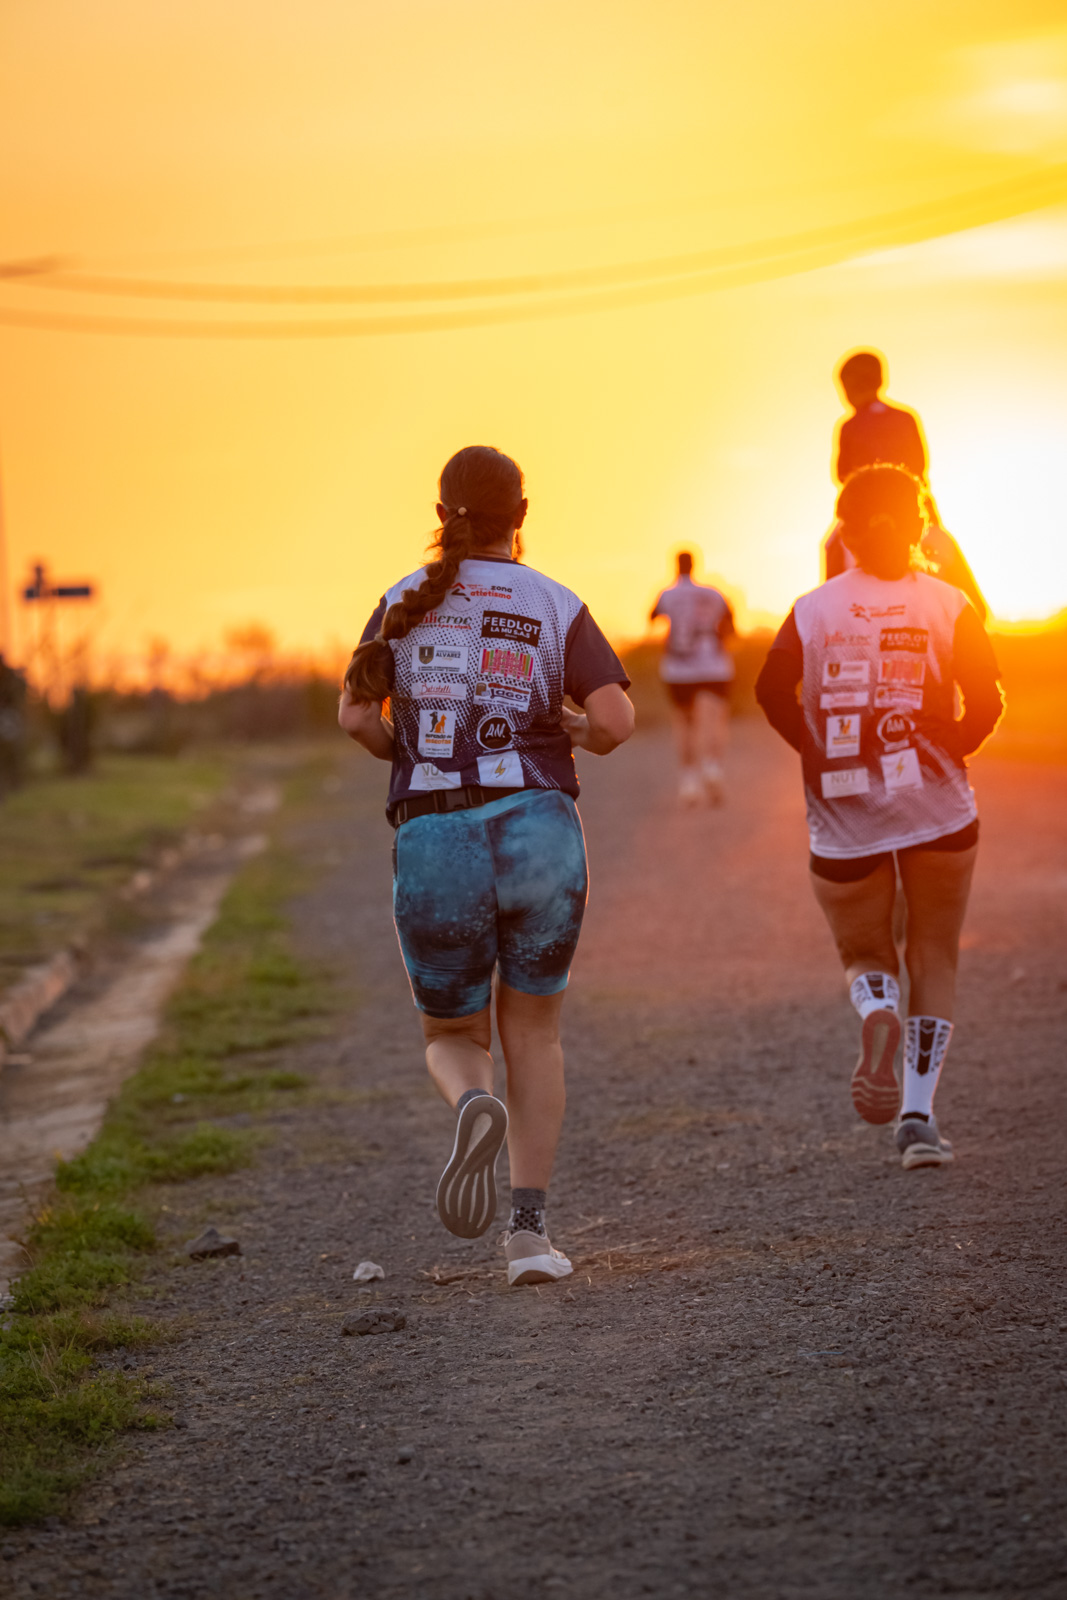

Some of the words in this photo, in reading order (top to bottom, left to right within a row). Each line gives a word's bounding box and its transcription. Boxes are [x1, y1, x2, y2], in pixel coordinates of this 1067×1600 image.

[470, 589, 512, 600] atletismo
[491, 585, 512, 593] zona
[483, 616, 540, 635] FEEDLOT
